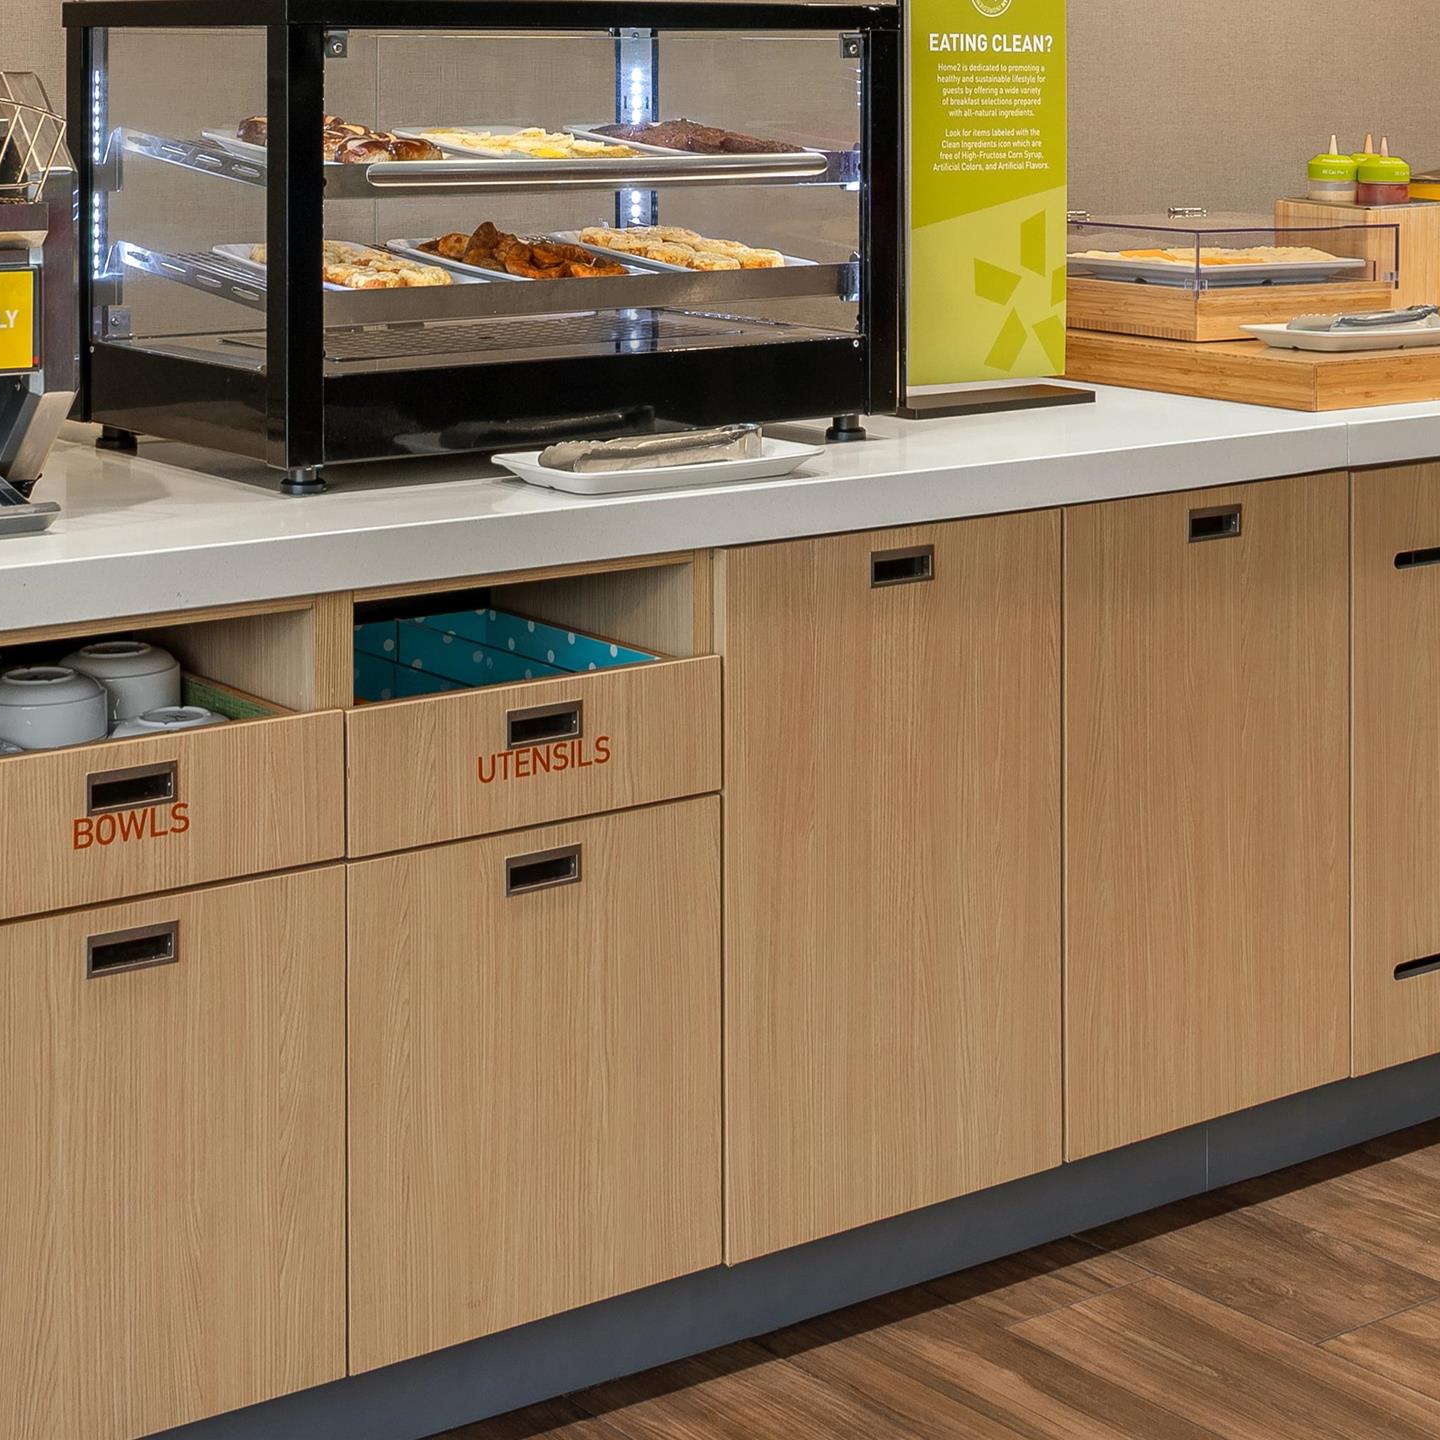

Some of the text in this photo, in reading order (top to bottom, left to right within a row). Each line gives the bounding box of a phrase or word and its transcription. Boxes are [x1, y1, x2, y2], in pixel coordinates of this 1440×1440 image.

[929, 33, 1052, 52] EATING CLEAN?
[1009, 64, 1039, 73] promoting
[937, 75, 960, 84] healthy
[1012, 75, 1035, 84] lifestyle
[965, 87, 973, 95] by
[974, 87, 998, 95] offering
[1021, 87, 1041, 95] variety
[1014, 98, 1041, 106] prepared
[999, 109, 1034, 118] ingredients.
[945, 129, 1040, 137] Look for items labeled with the
[942, 140, 960, 148] Clean
[961, 140, 997, 149] Ingredients
[998, 140, 1011, 148] icon
[940, 151, 953, 159] free
[954, 151, 961, 159] of
[962, 151, 1006, 160] High-Fructose
[1024, 151, 1043, 160] Syrup,
[933, 163, 960, 171] Artificial
[961, 162, 984, 171] Colors,
[985, 162, 997, 170] and
[1026, 161, 1049, 169] Flavors.
[478, 734, 611, 785] UTENSILS
[72, 801, 190, 851] BOWLS
